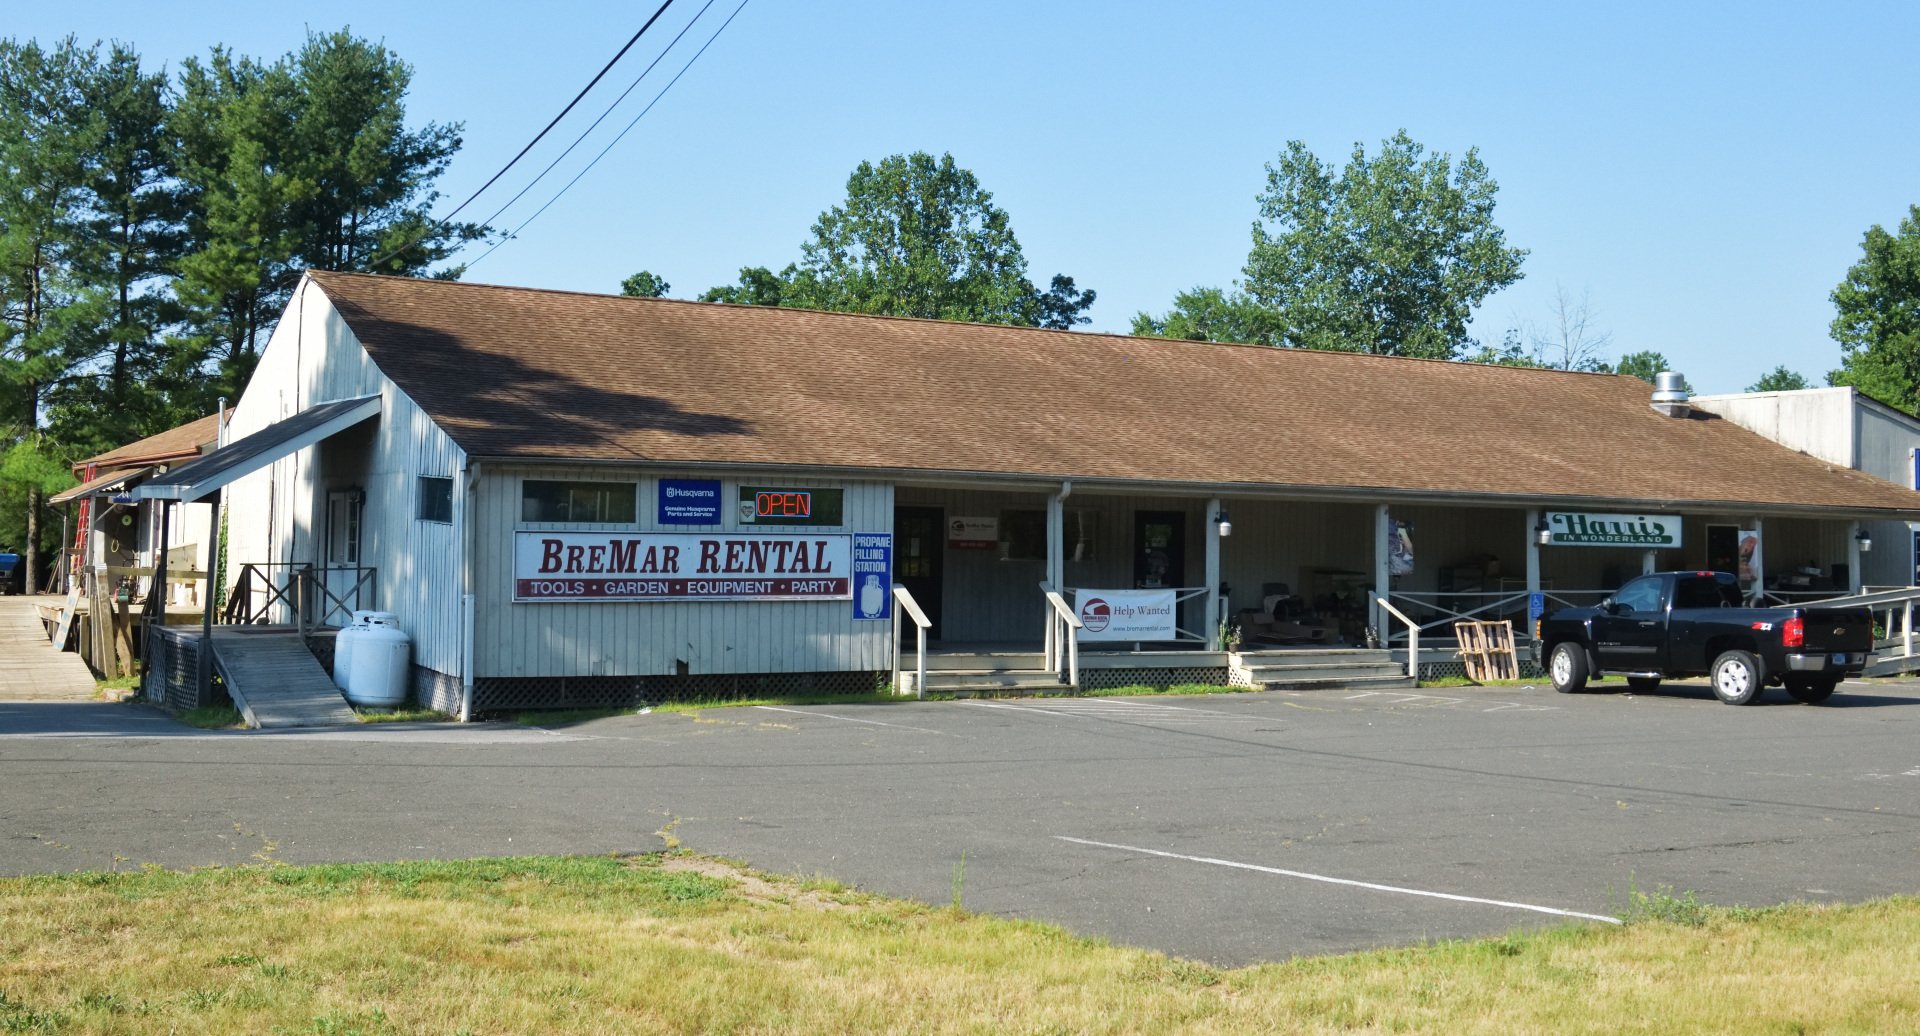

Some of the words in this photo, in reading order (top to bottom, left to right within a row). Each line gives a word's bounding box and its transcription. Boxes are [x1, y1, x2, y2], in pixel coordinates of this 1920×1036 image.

[675, 488, 714, 498] Husqvarna
[757, 493, 809, 515] OPEN
[1552, 514, 1665, 535] Harris
[855, 536, 891, 548] PROPANE
[1581, 534, 1662, 543] WONDERLAND
[696, 540, 832, 574] RENTAL
[855, 548, 884, 560] FILLING
[855, 561, 886, 573] STATION
[531, 581, 585, 594] TOOLS
[604, 581, 669, 594] GARDEN
[687, 581, 774, 594] EQUIPMENT
[791, 581, 837, 593] PARTY
[1114, 604, 1135, 619] Help
[1138, 604, 1170, 615] Wanted
